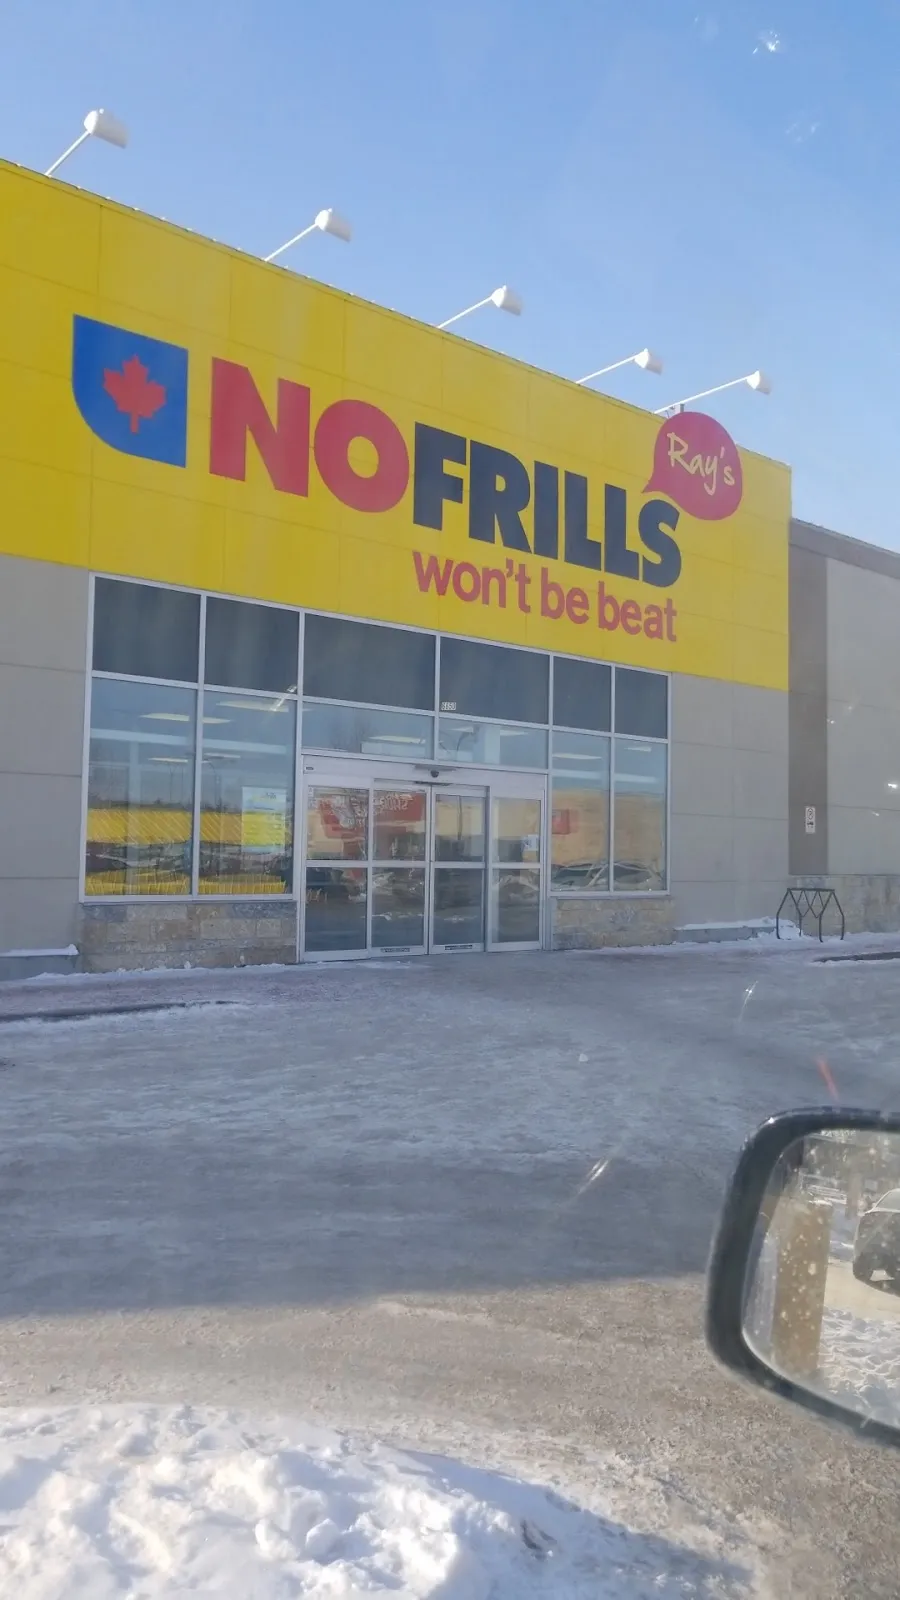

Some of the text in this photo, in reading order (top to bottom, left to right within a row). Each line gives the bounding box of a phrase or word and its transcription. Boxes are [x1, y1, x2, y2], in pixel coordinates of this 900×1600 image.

[666, 431, 735, 496] Ray's
[412, 550, 677, 642] won't be beat
